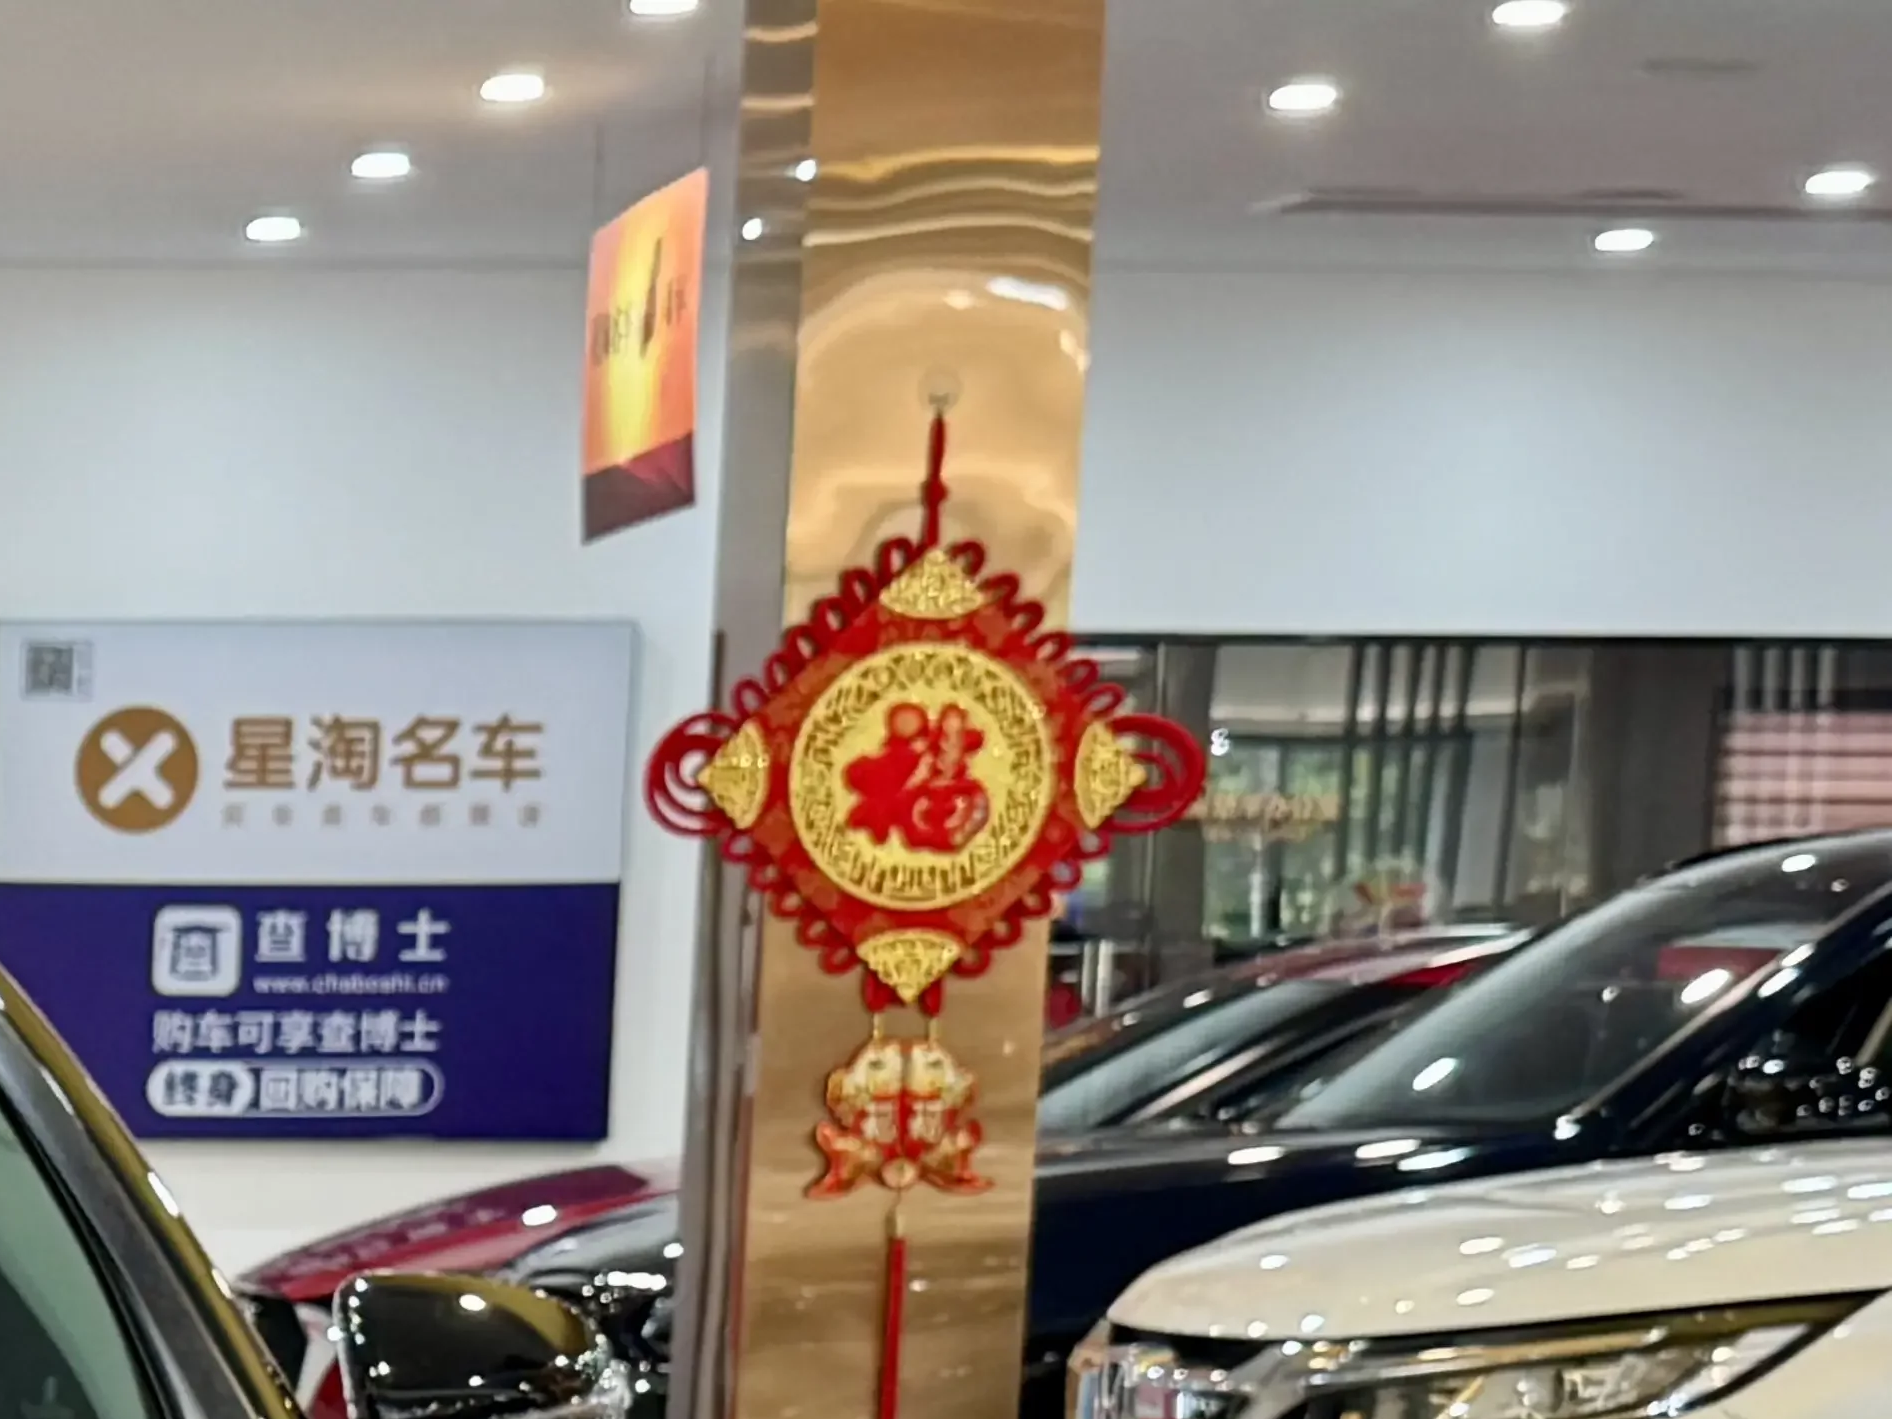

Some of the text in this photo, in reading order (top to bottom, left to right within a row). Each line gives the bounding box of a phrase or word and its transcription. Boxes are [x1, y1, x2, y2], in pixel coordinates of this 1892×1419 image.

[223, 713, 545, 793] 星淘名车
[253, 906, 453, 963] 查博士
[151, 1008, 443, 1054] 购车可享查博士
